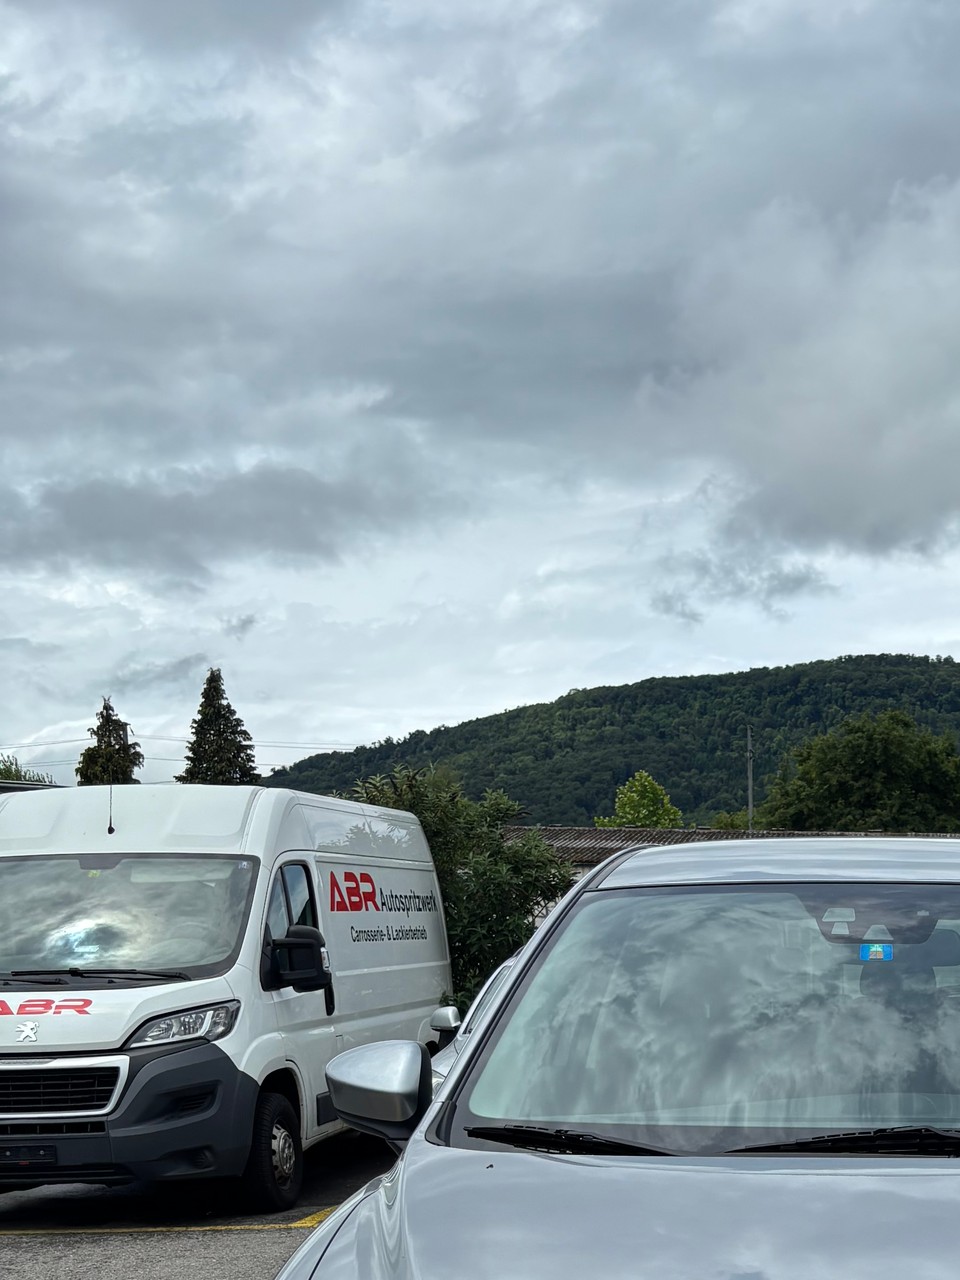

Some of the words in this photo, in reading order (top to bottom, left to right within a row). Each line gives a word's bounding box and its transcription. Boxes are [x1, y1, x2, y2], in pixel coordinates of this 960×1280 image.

[329, 870, 381, 912] ABR
[380, 887, 438, 918] Autospritzwerk
[350, 925, 386, 942] Carrosserie-
[391, 925, 428, 941] Lackierbetrieb
